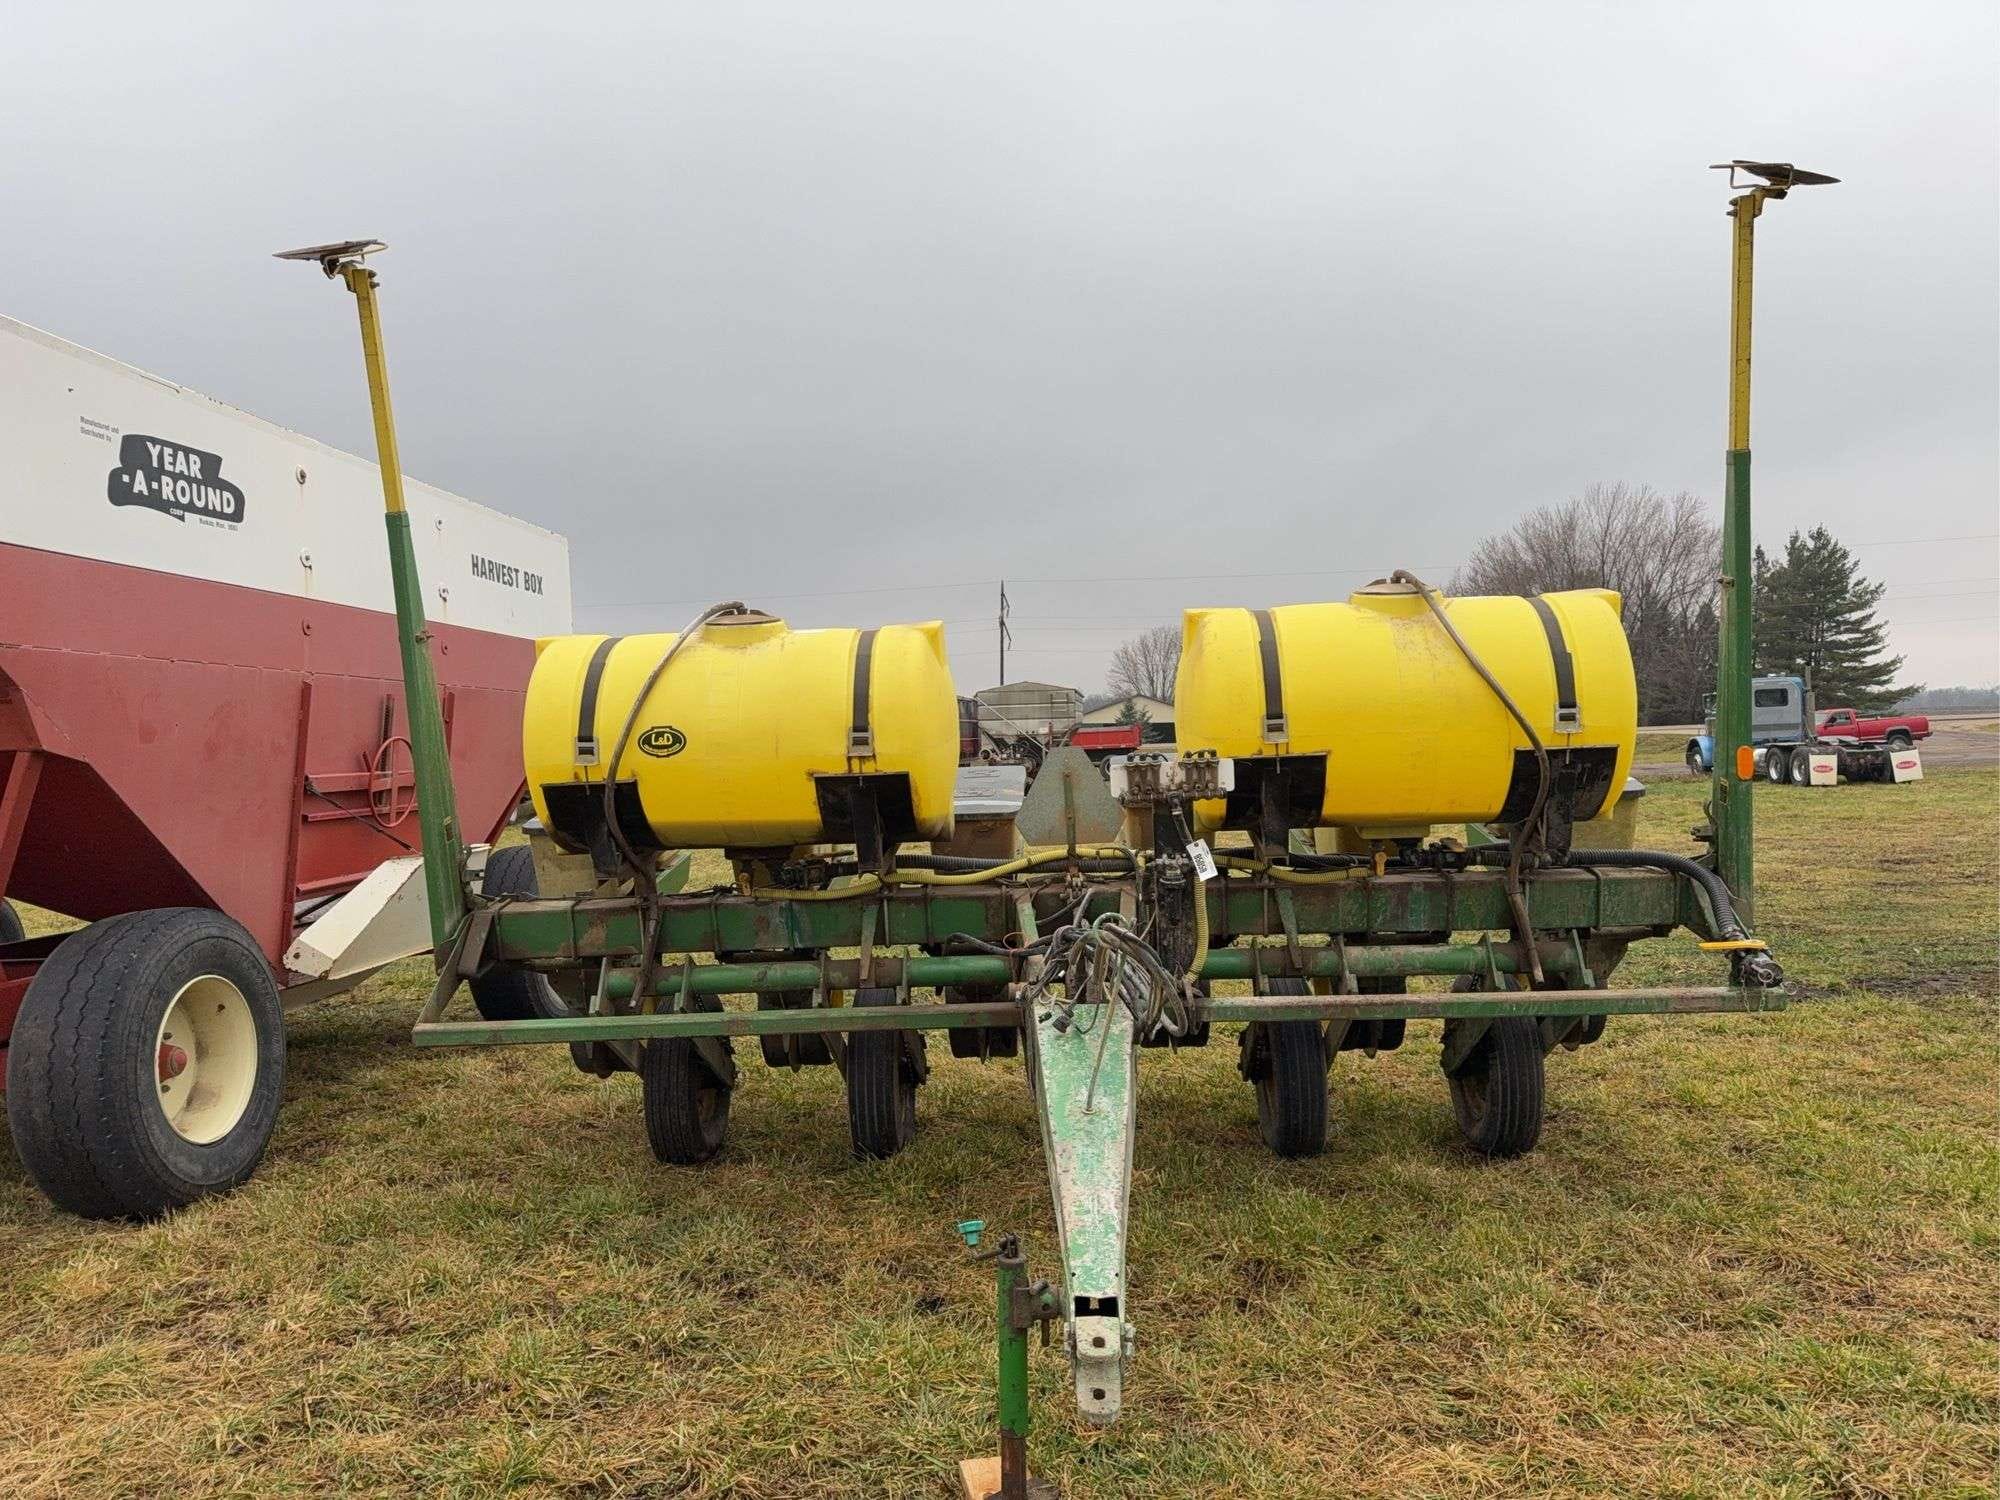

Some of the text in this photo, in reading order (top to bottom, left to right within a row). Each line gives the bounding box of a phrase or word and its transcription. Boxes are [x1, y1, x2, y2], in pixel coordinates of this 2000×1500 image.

[145, 441, 202, 479] YEAR
[471, 553, 544, 596] HARVEST BOX
[651, 733, 673, 746] L&D
